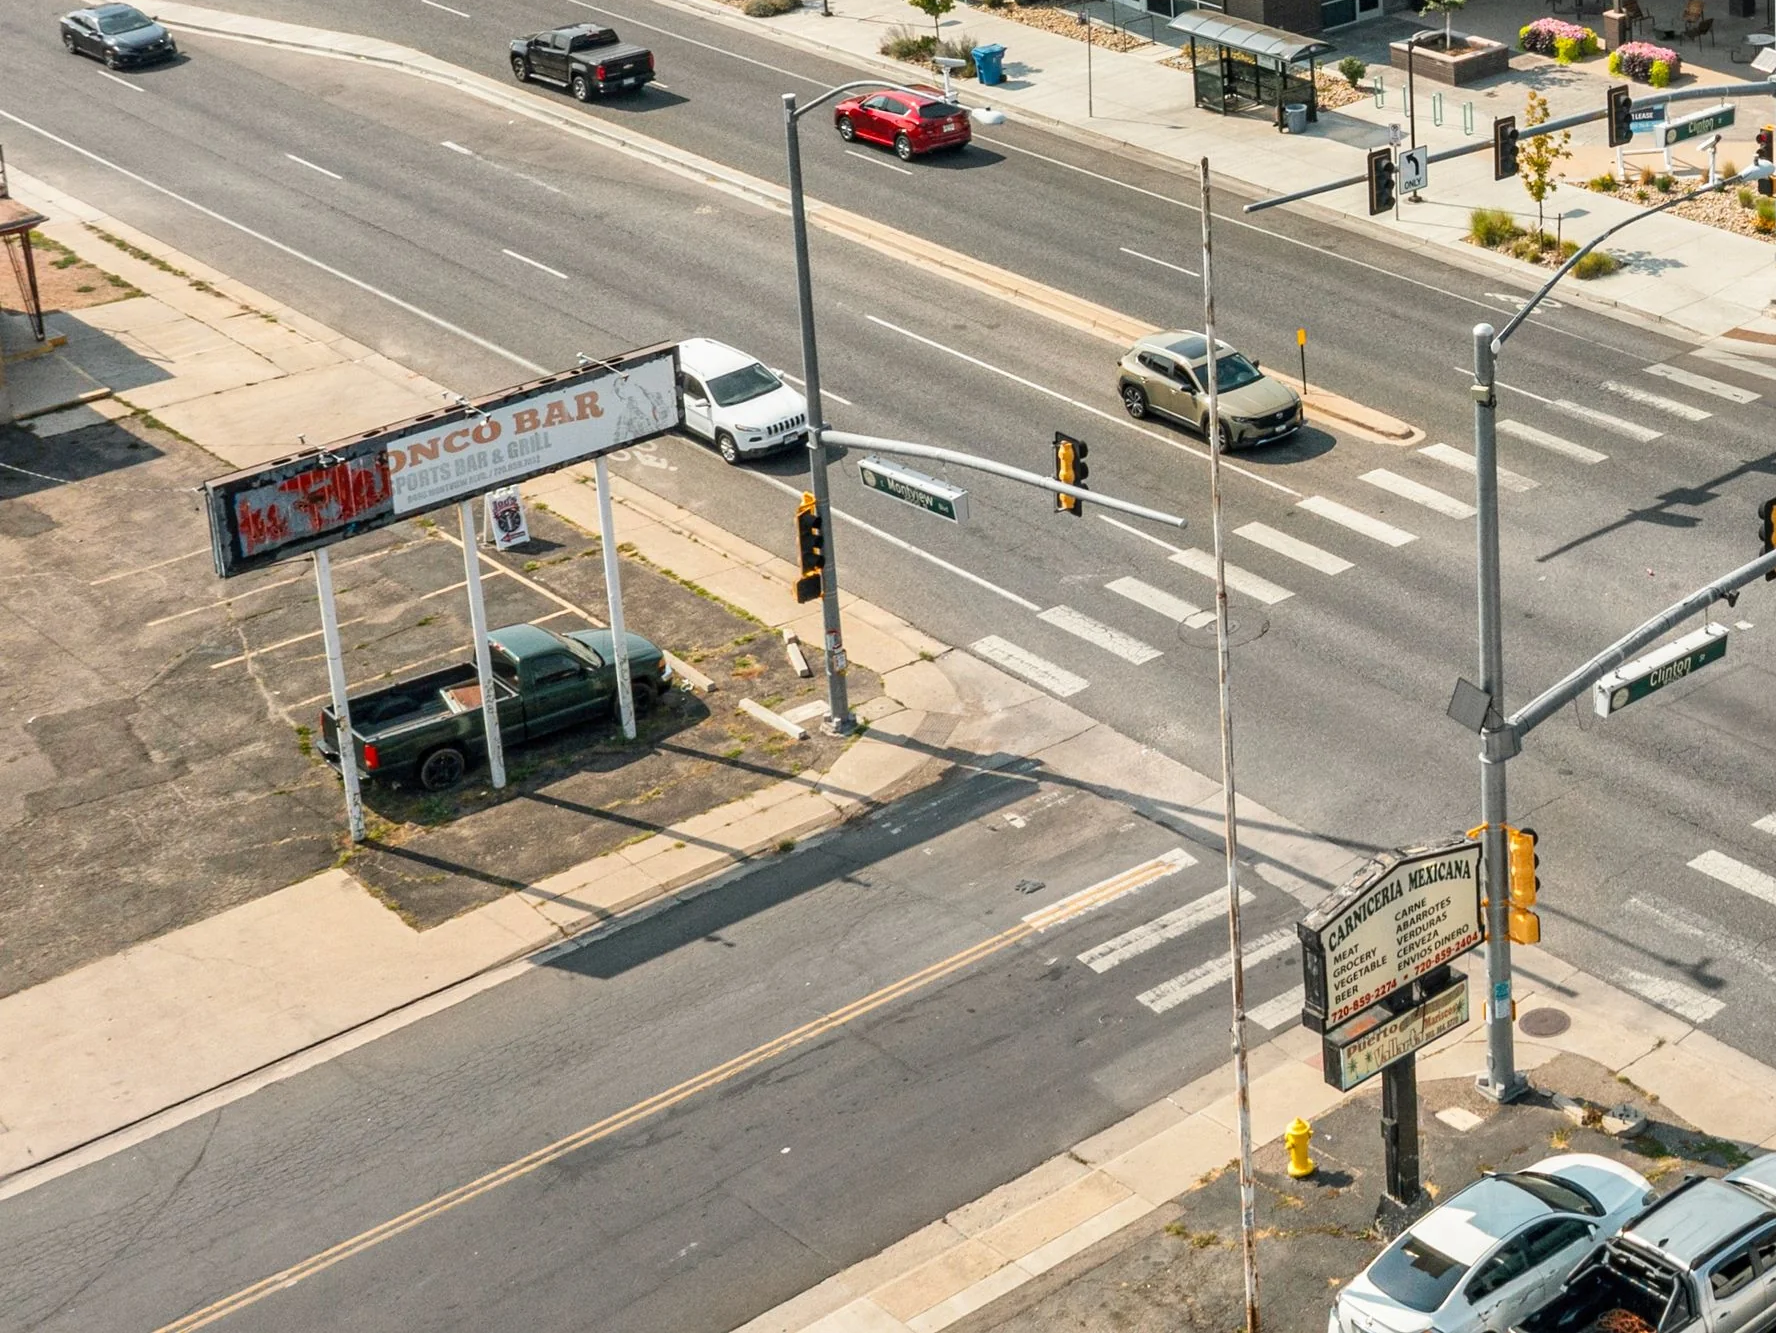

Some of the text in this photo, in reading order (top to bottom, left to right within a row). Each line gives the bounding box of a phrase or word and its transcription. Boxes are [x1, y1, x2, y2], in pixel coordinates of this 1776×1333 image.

[1688, 118, 1714, 134] Clinton
[1404, 177, 1421, 190] ONLY
[512, 390, 604, 435] BAR
[453, 450, 488, 477] BAR
[492, 448, 503, 464] &
[507, 431, 552, 459] GRILL
[887, 478, 933, 506] Montview
[1650, 656, 1691, 686] Clinton
[1328, 859, 1471, 952] CARNICERIA MEXICANA
[1394, 897, 1427, 921] CARNE
[1395, 896, 1452, 935] ABARROTES
[1396, 911, 1447, 946] VERDURAS
[1397, 929, 1439, 959] CERVEZA
[1333, 943, 1360, 966] MEAT
[1333, 947, 1377, 979] GROCERY
[1397, 923, 1469, 971] ENVIOS DINERO
[1331, 931, 1478, 1024] 720-859-2274 720-859-2404
[1334, 955, 1388, 991] VEGETABLE
[1335, 984, 1359, 1005] BEER
[1423, 1003, 1458, 1029] Mariscos
[1346, 1023, 1398, 1059] Puerto
